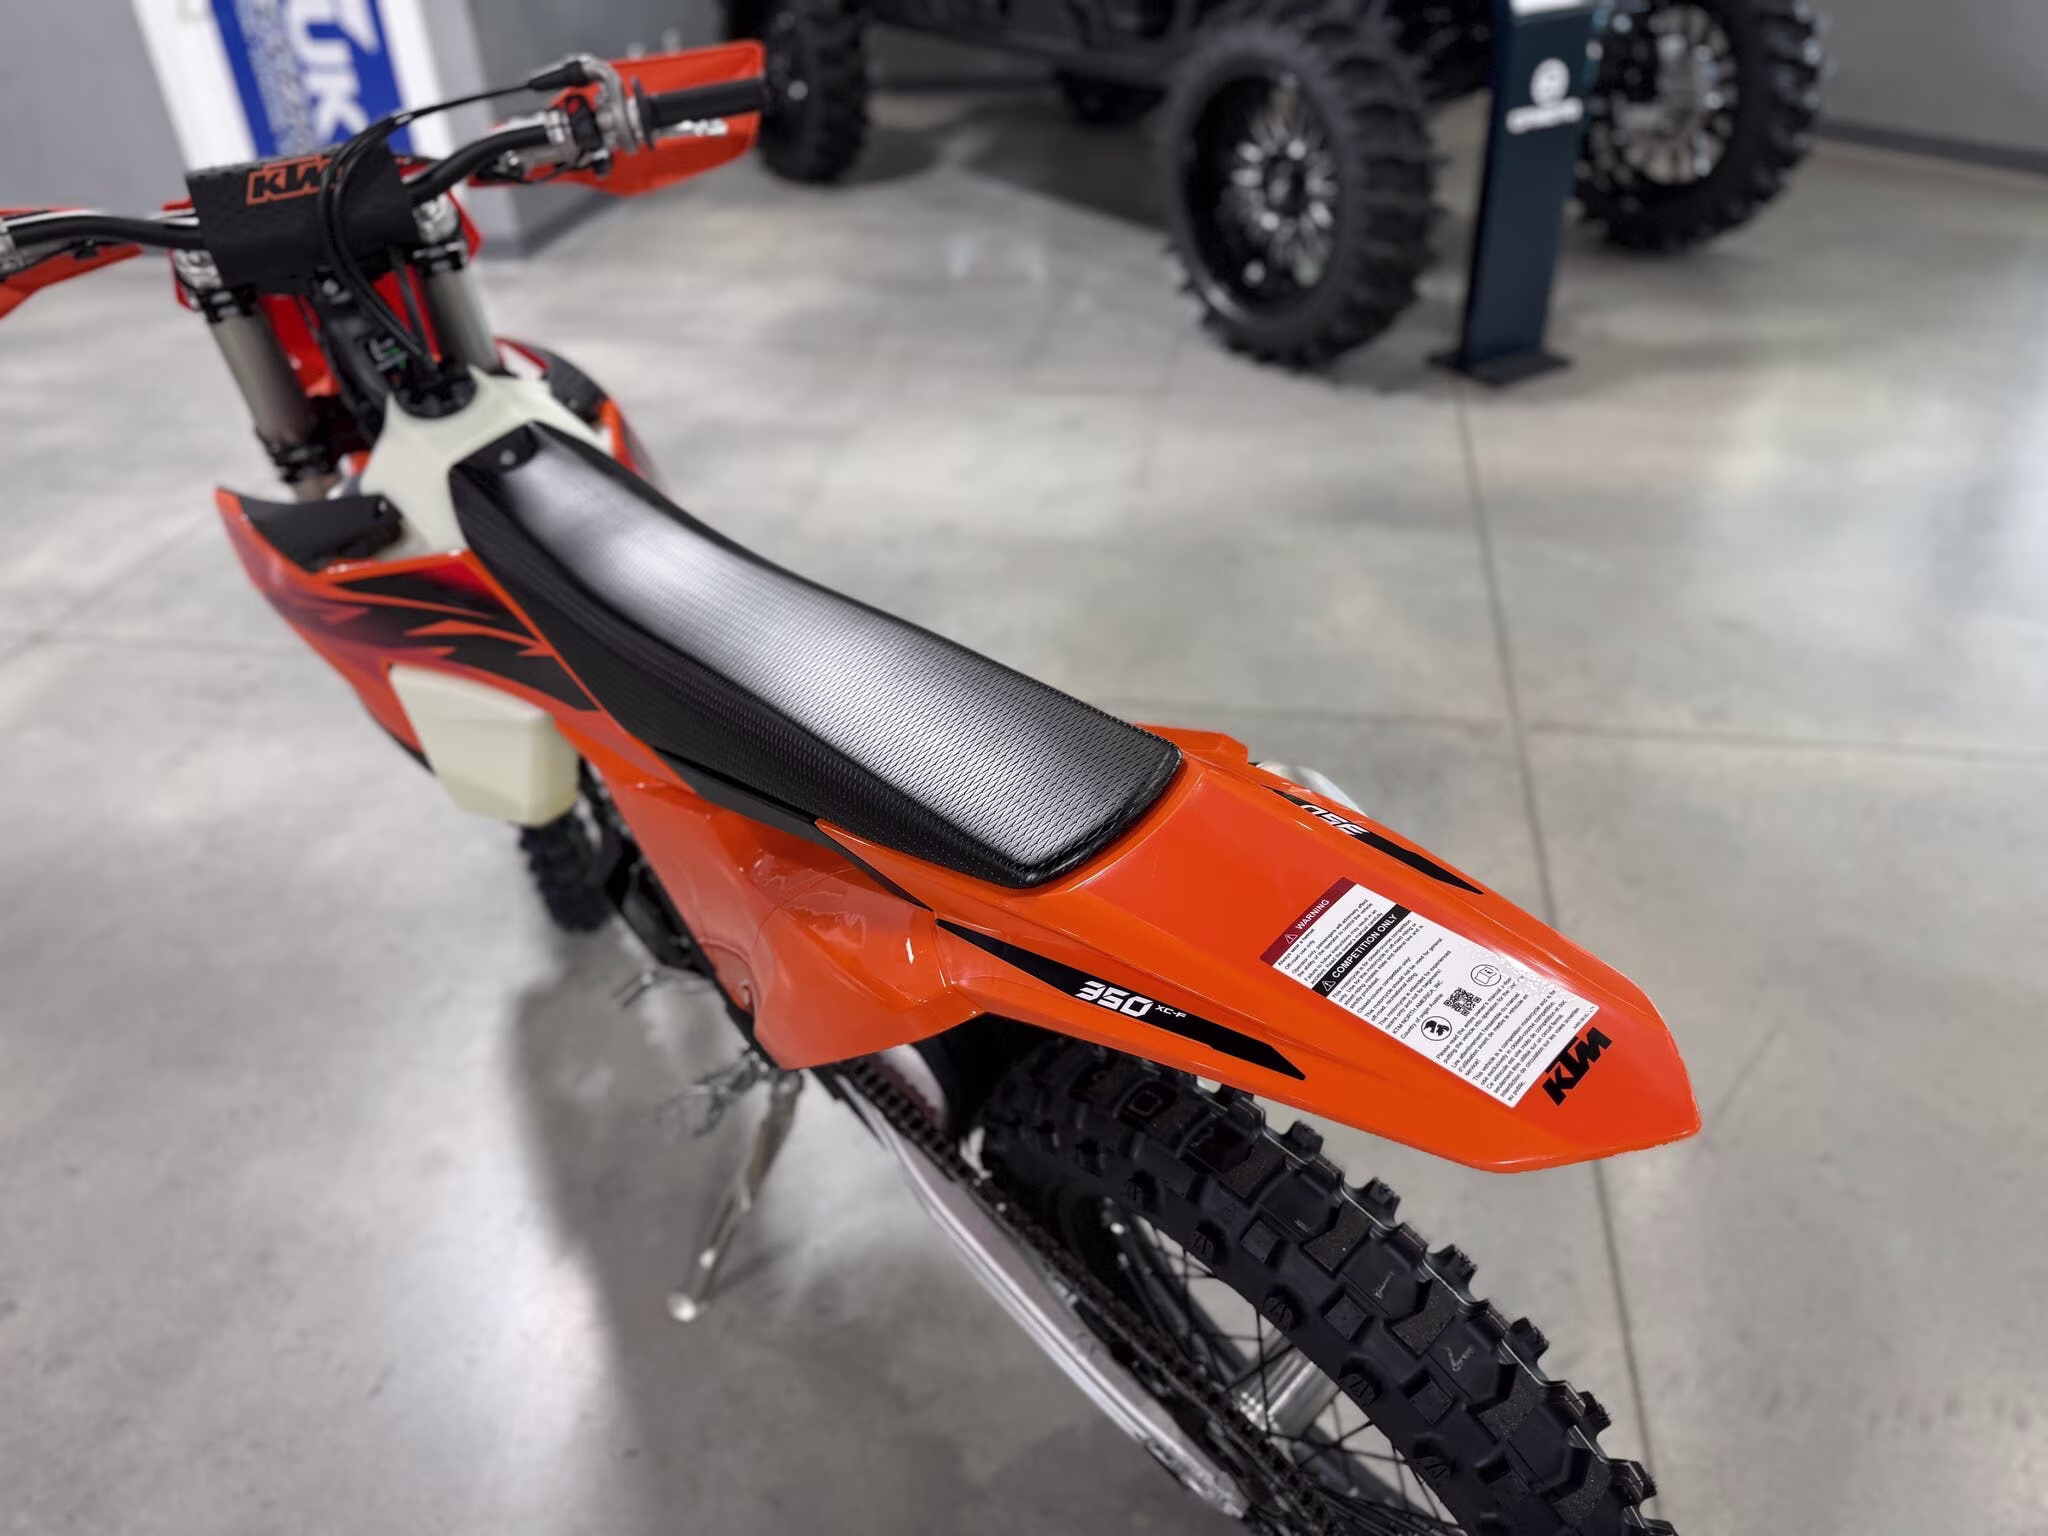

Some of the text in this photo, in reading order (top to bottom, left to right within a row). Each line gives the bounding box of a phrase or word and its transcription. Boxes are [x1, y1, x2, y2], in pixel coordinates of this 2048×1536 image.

[246, 153, 346, 206] KTM
[1295, 898, 1330, 930] WARNING
[1277, 952, 1293, 967] Always
[1290, 943, 1301, 953] wear
[1291, 957, 1310, 975] Operator
[1315, 929, 1338, 950] passengers
[1323, 934, 1340, 950] operator
[1324, 957, 1338, 969] Read
[1354, 925, 1370, 939] manual
[1331, 913, 1398, 979] COMPETITION ONLY
[1331, 989, 1343, 999] This
[1339, 969, 1361, 991] motorcycle
[1390, 919, 1412, 939] competition
[1364, 969, 1380, 984] violates
[1392, 940, 1407, 954] federal
[1358, 971, 1368, 980] this
[1365, 952, 1387, 973] motorcycle
[1377, 1016, 1389, 1026] This
[1386, 995, 1408, 1018] motorcycle
[1408, 975, 1426, 993] intended
[1429, 950, 1452, 972] experienced
[1381, 965, 1404, 987] competition
[1075, 980, 1188, 1019] 350 XC-F
[1364, 1008, 1375, 1018] This
[1372, 988, 1394, 1010] motorcycle
[1390, 975, 1406, 989] should
[1395, 1007, 1407, 1018] only
[1399, 1022, 1418, 1040] Country
[1428, 992, 1444, 1008] Austria
[1400, 1007, 1418, 1025] NORTH
[1435, 1044, 1452, 1060] Please
[1448, 1034, 1460, 1045] read
[1463, 1016, 1476, 1029] entire
[1487, 987, 1503, 1003] manual
[1442, 1048, 1459, 1065] putting
[1461, 1026, 1476, 1042] vehicle
[1480, 1001, 1500, 1021] operation
[1472, 1070, 1484, 1081] This
[1481, 1056, 1497, 1072] vehicle
[1500, 1025, 1523, 1050] competition
[1520, 1005, 1542, 1028] motorcycle
[1542, 1026, 1613, 1107] KTM
